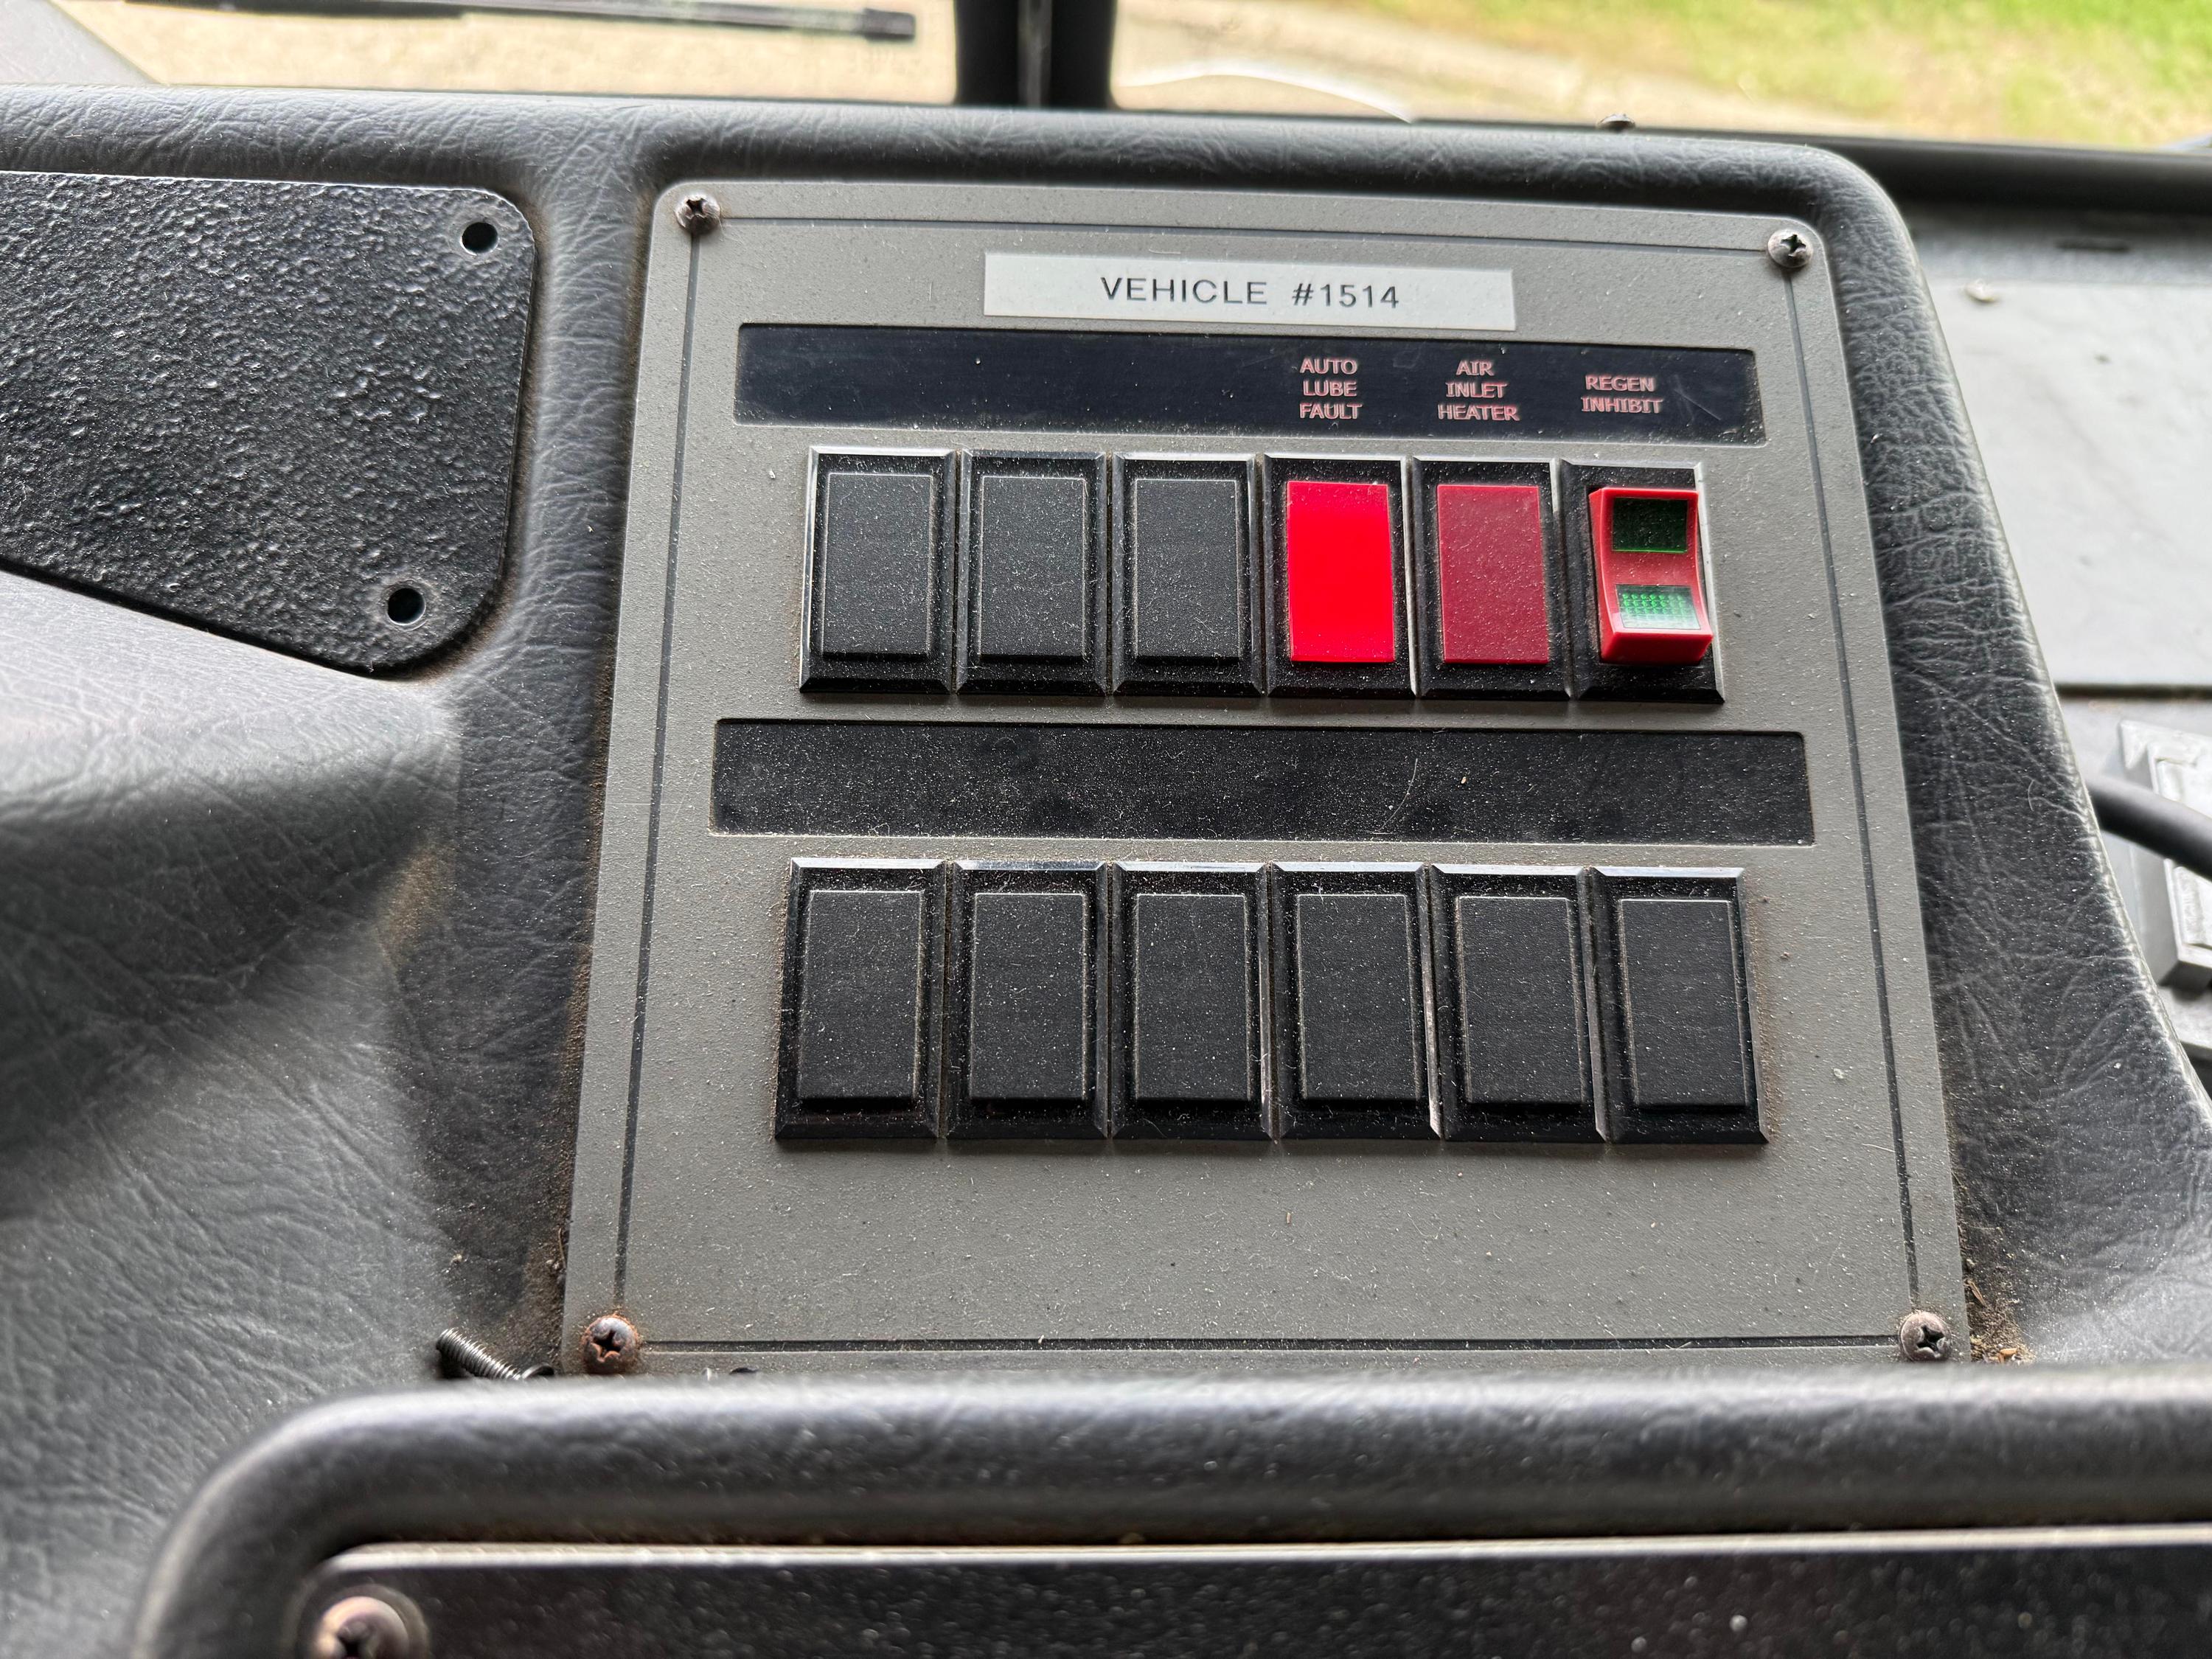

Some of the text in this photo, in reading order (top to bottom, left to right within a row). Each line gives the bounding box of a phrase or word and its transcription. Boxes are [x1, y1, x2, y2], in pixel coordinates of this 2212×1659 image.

[1101, 277, 1399, 308] VEHICLE #1514
[1300, 358, 1358, 375] AUTO
[1456, 360, 1495, 376] AIR
[1304, 380, 1357, 397] LUBE
[1446, 382, 1508, 399] INLET
[1585, 375, 1655, 392] REGEN
[1300, 403, 1363, 420] FAULT
[1438, 404, 1520, 421] HEATER
[1581, 397, 1663, 414] INHIBIT
